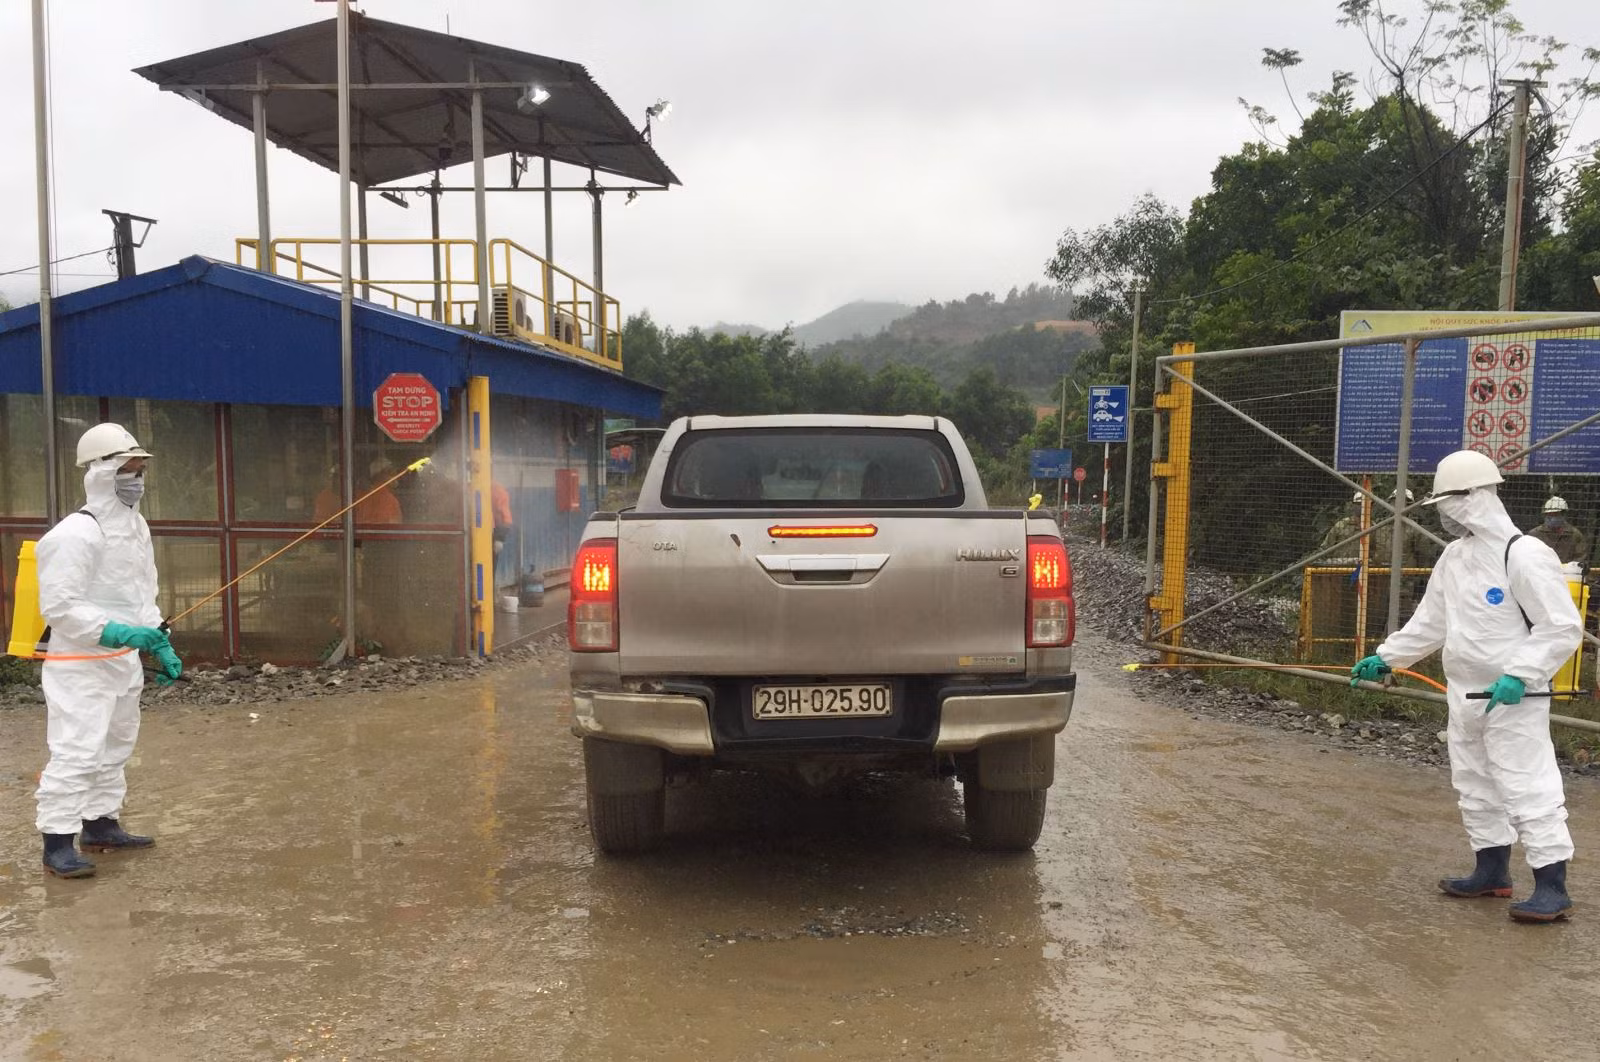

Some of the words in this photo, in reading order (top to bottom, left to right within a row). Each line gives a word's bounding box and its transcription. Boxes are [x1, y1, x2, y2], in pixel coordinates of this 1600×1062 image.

[383, 396, 433, 408] STOP
[956, 547, 1021, 562] HILUX
[759, 687, 887, 714] 29H-025.90
